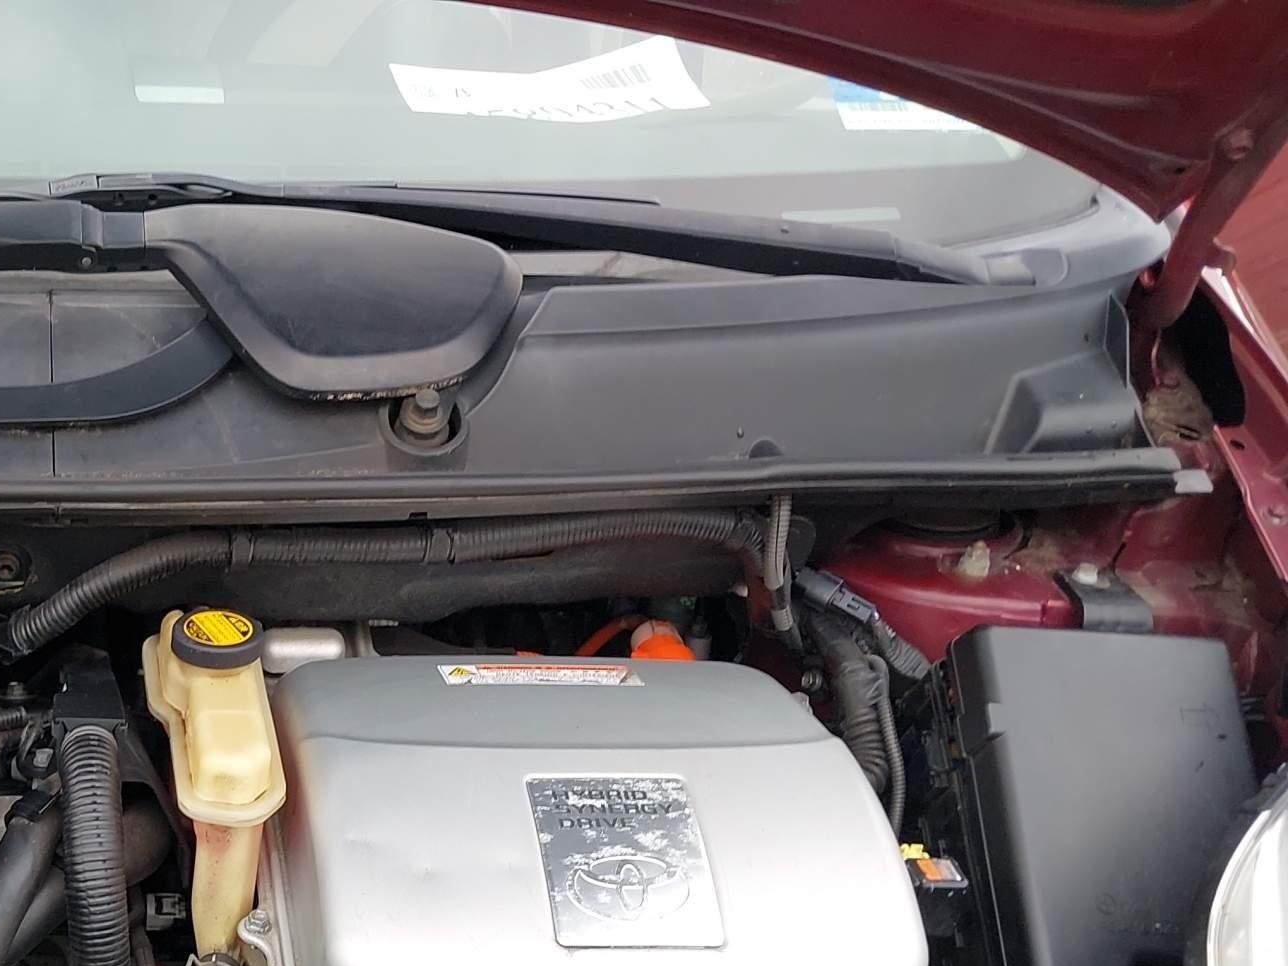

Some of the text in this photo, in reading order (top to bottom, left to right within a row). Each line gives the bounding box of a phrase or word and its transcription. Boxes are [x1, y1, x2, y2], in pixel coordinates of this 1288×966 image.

[552, 789, 648, 800] HYBRID
[554, 802, 672, 815] SYNERGY
[558, 817, 637, 829] DRIVE
